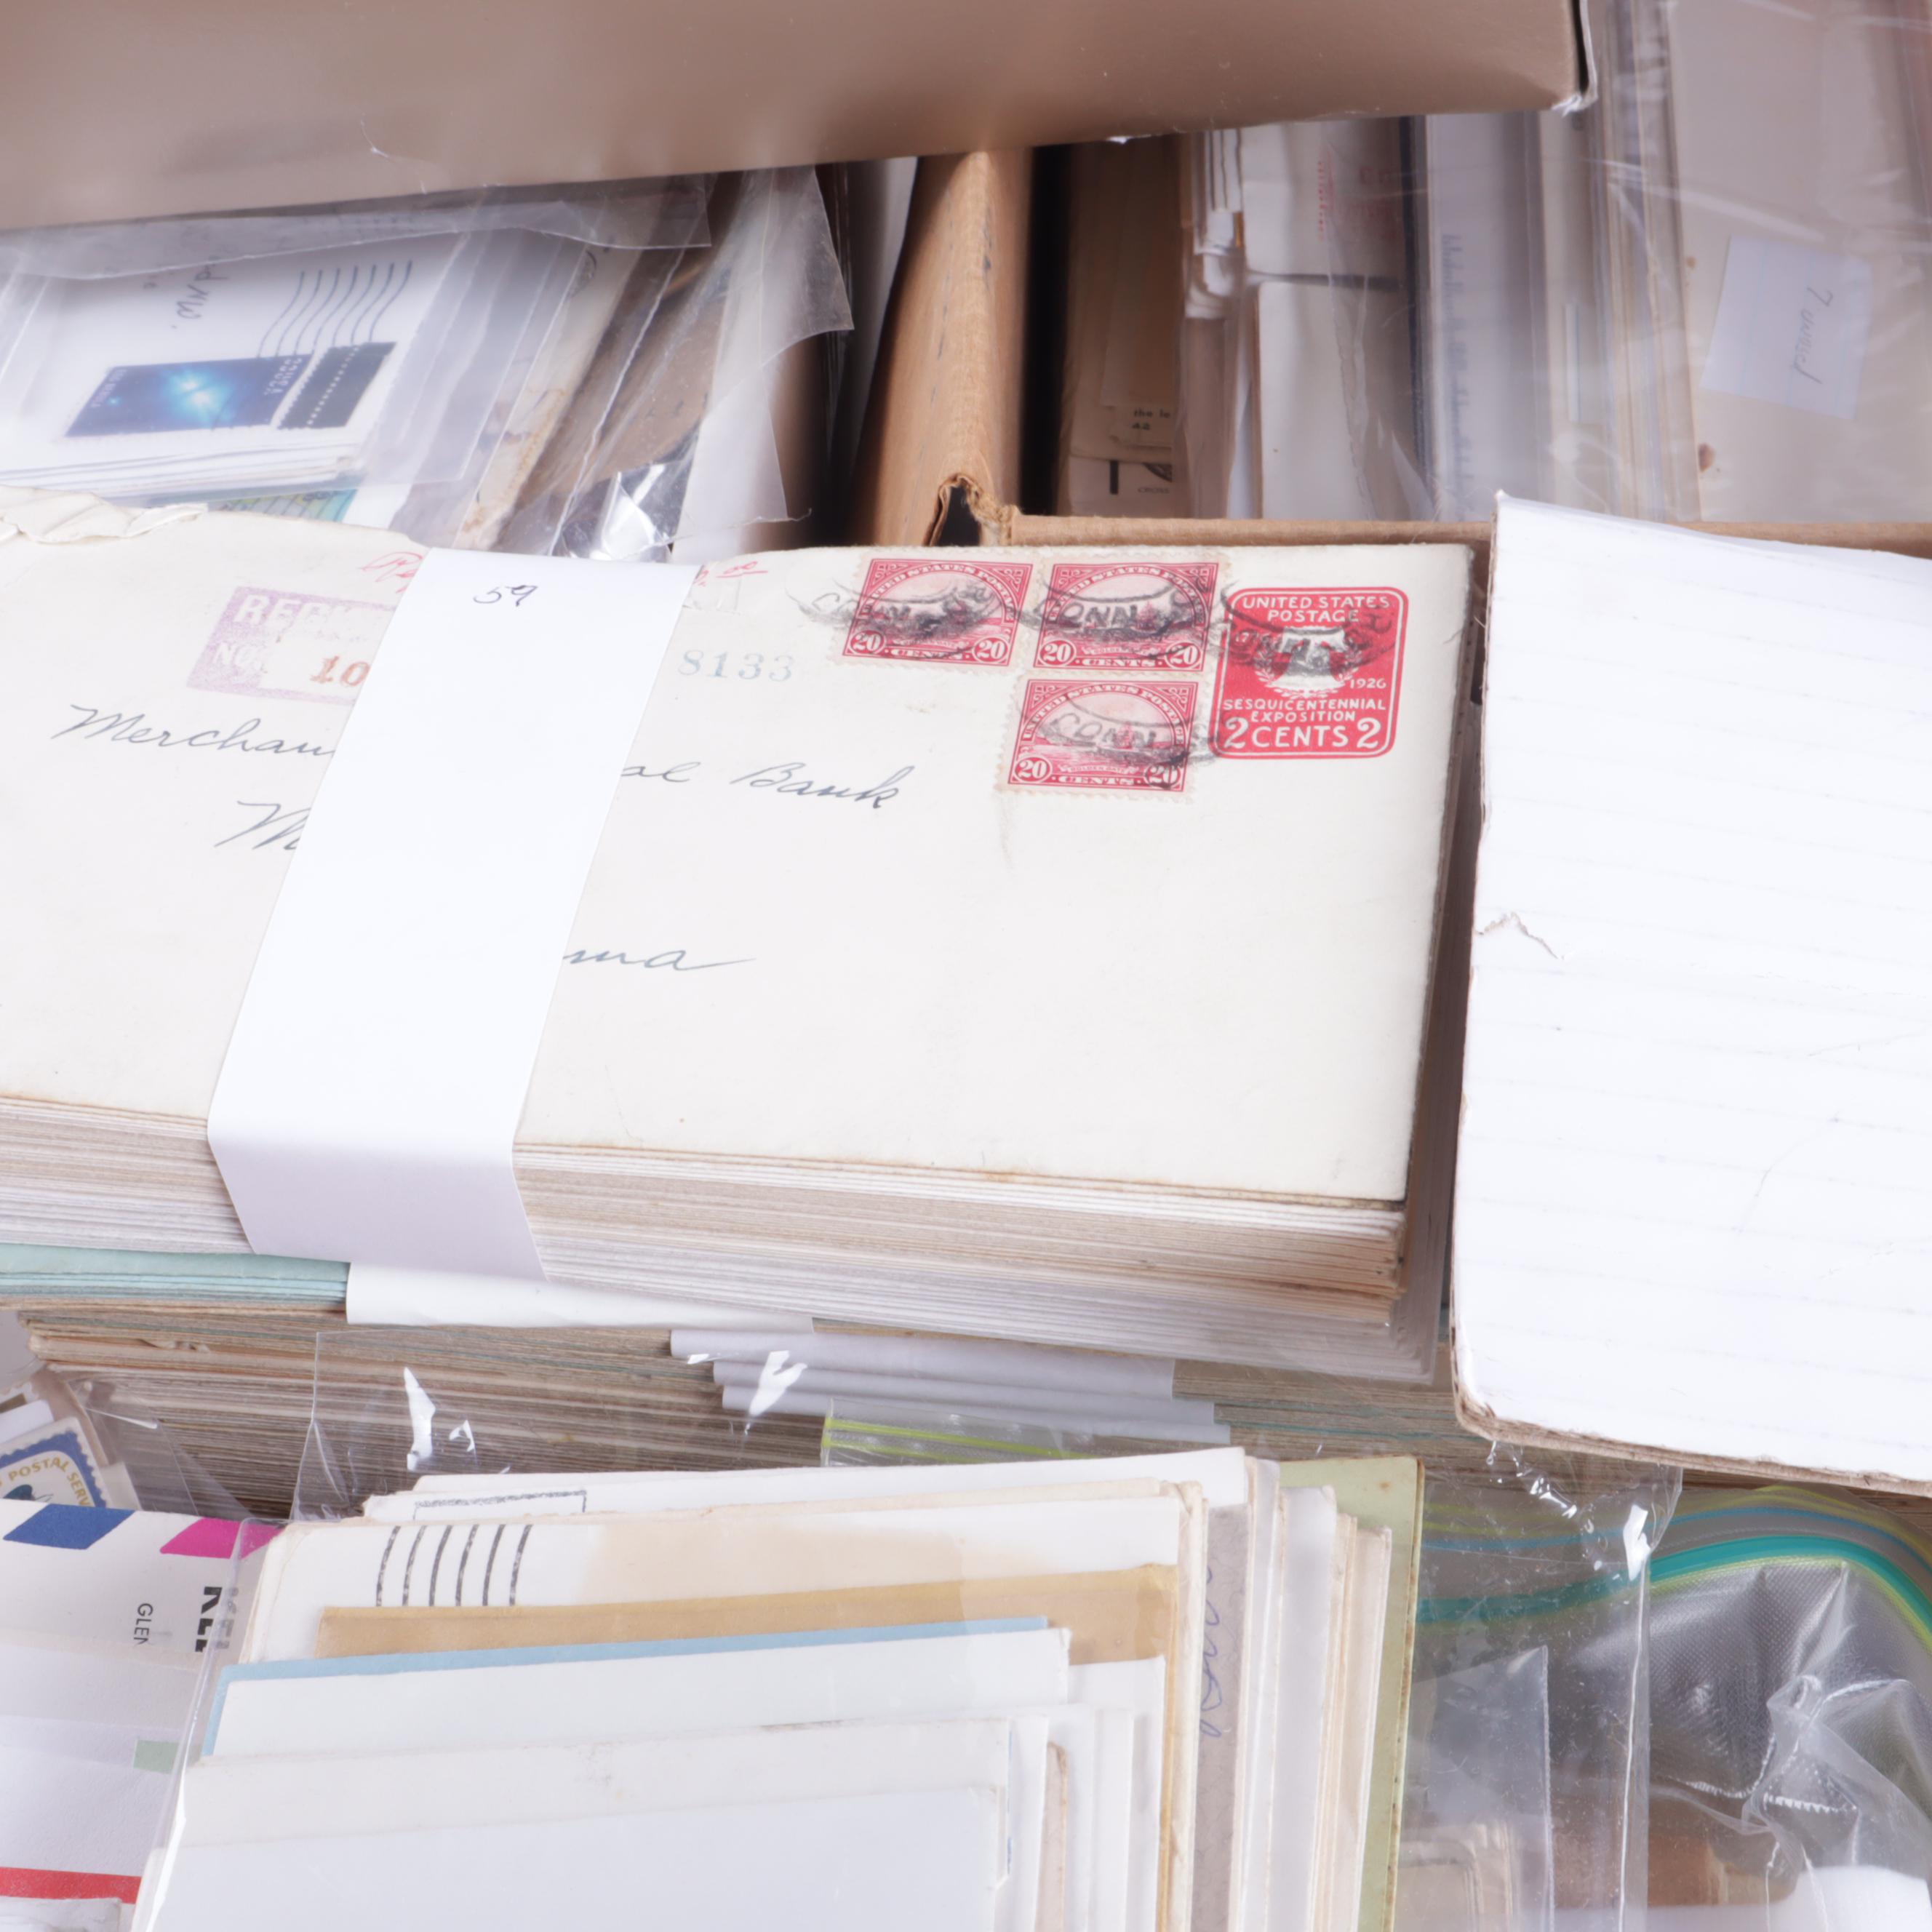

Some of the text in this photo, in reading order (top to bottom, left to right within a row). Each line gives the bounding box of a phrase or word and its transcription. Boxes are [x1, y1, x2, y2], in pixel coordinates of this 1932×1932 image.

[908, 564, 975, 578] STATES
[1092, 565, 1162, 581] STATES
[472, 584, 538, 608] 59
[1242, 596, 1389, 609] UNITED STATES
[1268, 610, 1359, 622] POSTAGE
[852, 631, 882, 652] 20
[974, 639, 1007, 660] 20
[1044, 644, 1073, 663] 20
[1081, 658, 1151, 668] CENTS
[1168, 644, 1197, 666] 20
[676, 649, 794, 682] 8133
[1349, 678, 1386, 689] 1926
[1066, 684, 1141, 699] STATES
[1141, 690, 1185, 745] POSTAGE
[1223, 698, 1386, 711] SESQUICENTENNIAL
[1250, 710, 1356, 722] EXPOSITION
[1224, 716, 1249, 749] 2
[1251, 724, 1349, 748] CENTS
[1356, 716, 1382, 749] 2
[729, 762, 916, 809] Bank
[1018, 761, 1178, 786] 20 CENTS 20
[8, 1457, 70, 1482] POSTAL
